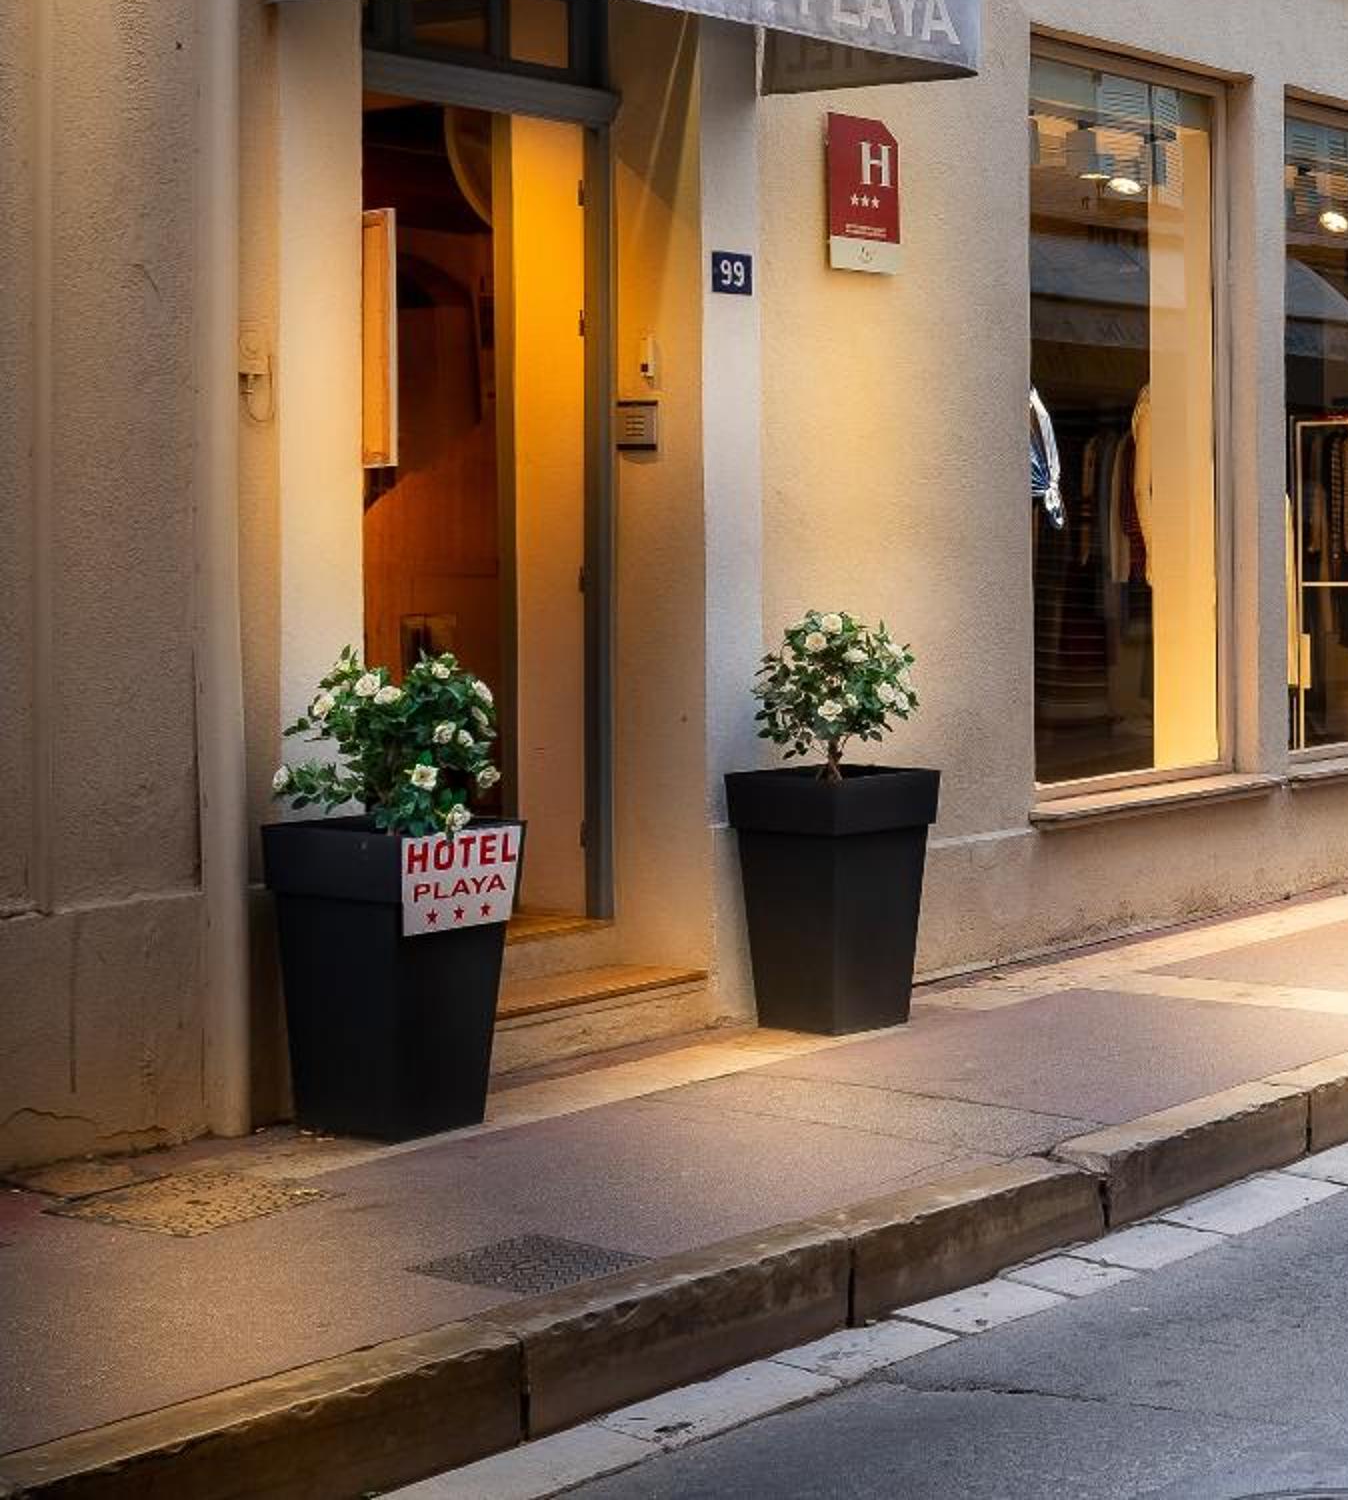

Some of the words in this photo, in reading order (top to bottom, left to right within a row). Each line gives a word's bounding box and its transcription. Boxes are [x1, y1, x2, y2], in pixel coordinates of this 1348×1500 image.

[860, 141, 893, 187] H
[719, 259, 746, 287] 99
[407, 832, 517, 874] HOTEL
[413, 873, 507, 903] PLAYA
